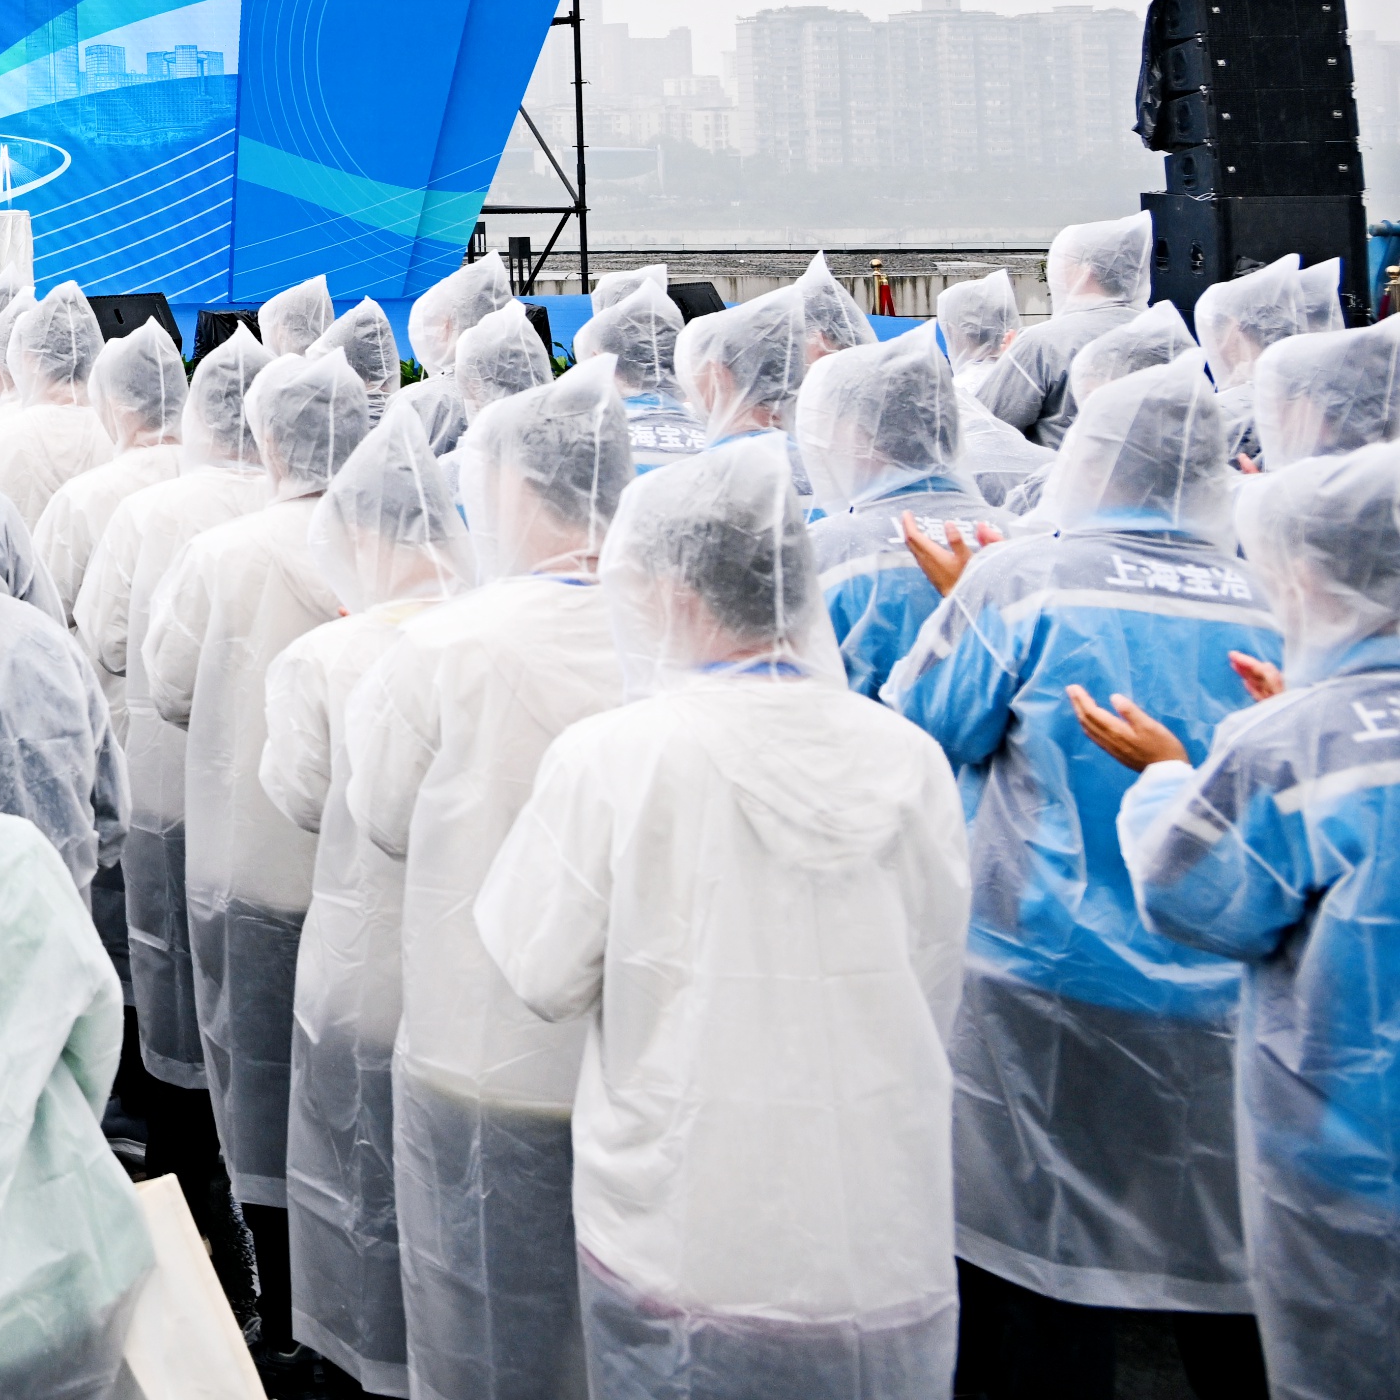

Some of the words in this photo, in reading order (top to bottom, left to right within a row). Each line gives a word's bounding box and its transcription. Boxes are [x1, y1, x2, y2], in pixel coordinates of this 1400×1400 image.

[1105, 554, 1253, 601] 上海宝冶
[1352, 696, 1400, 742] 上
